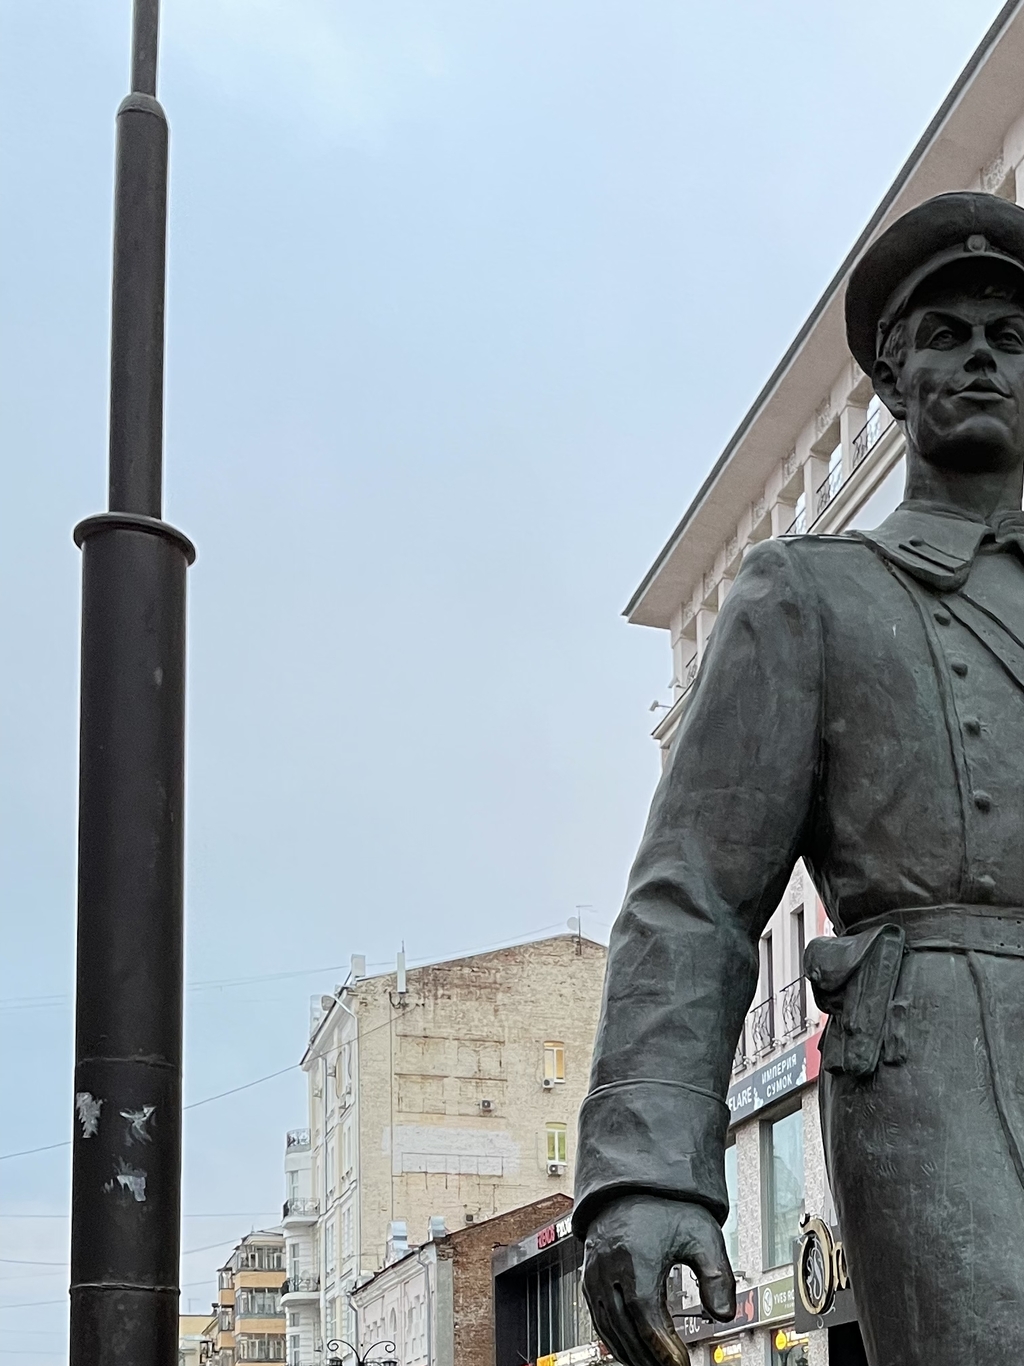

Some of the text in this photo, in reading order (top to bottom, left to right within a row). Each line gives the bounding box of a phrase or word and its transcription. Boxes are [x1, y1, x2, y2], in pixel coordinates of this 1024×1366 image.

[761, 1053, 797, 1085] ИМПЕРИЯ
[766, 1073, 793, 1098] СУМОК
[773, 1291, 787, 1305] YVES
